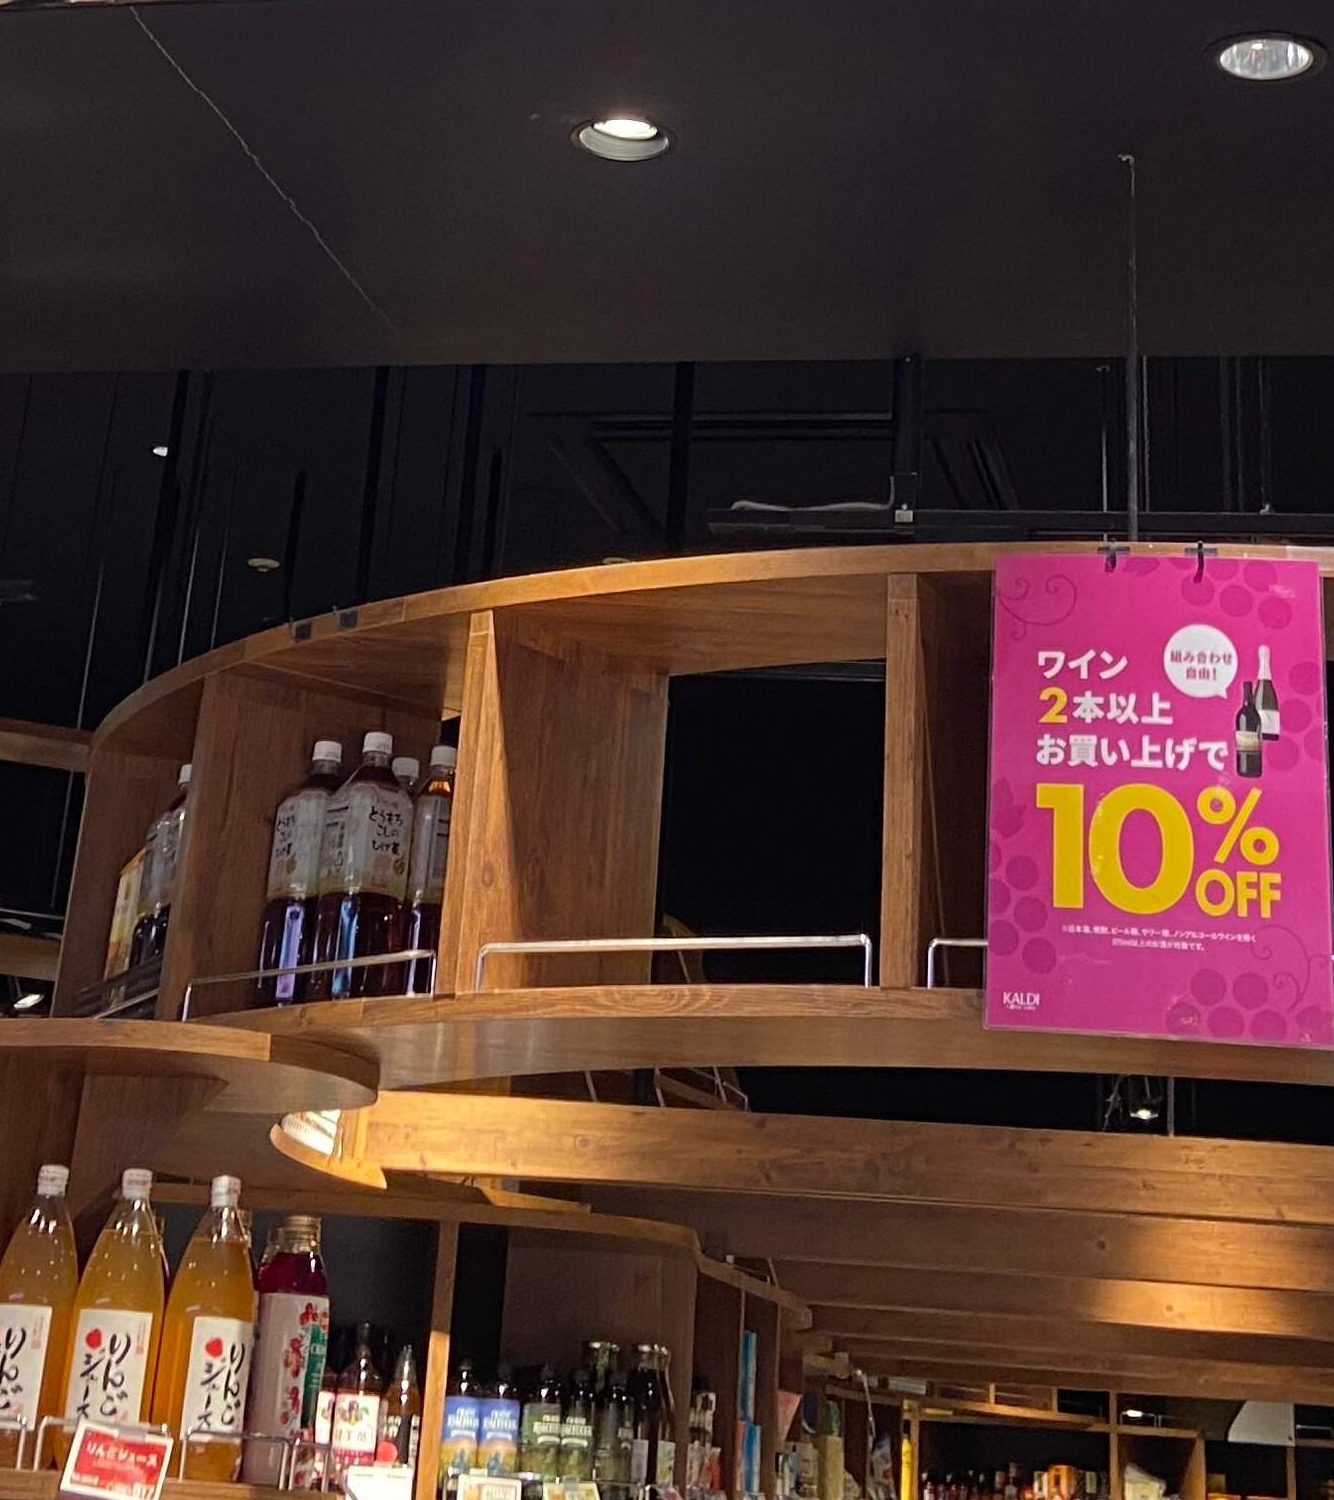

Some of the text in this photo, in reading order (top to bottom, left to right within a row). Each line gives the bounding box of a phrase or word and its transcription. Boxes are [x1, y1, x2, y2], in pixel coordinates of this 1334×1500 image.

[1037, 649, 1128, 680] ワイン
[1170, 650, 1233, 665] 組み合わせ
[1038, 686, 1174, 726] 2本以上
[1036, 733, 1229, 772] お買い上げで
[1035, 783, 1280, 915] 10%
[1195, 869, 1282, 919] OFF
[1002, 991, 1041, 1006] KALDI
[99, 1333, 131, 1417] りんご
[221, 1343, 245, 1425] りんご
